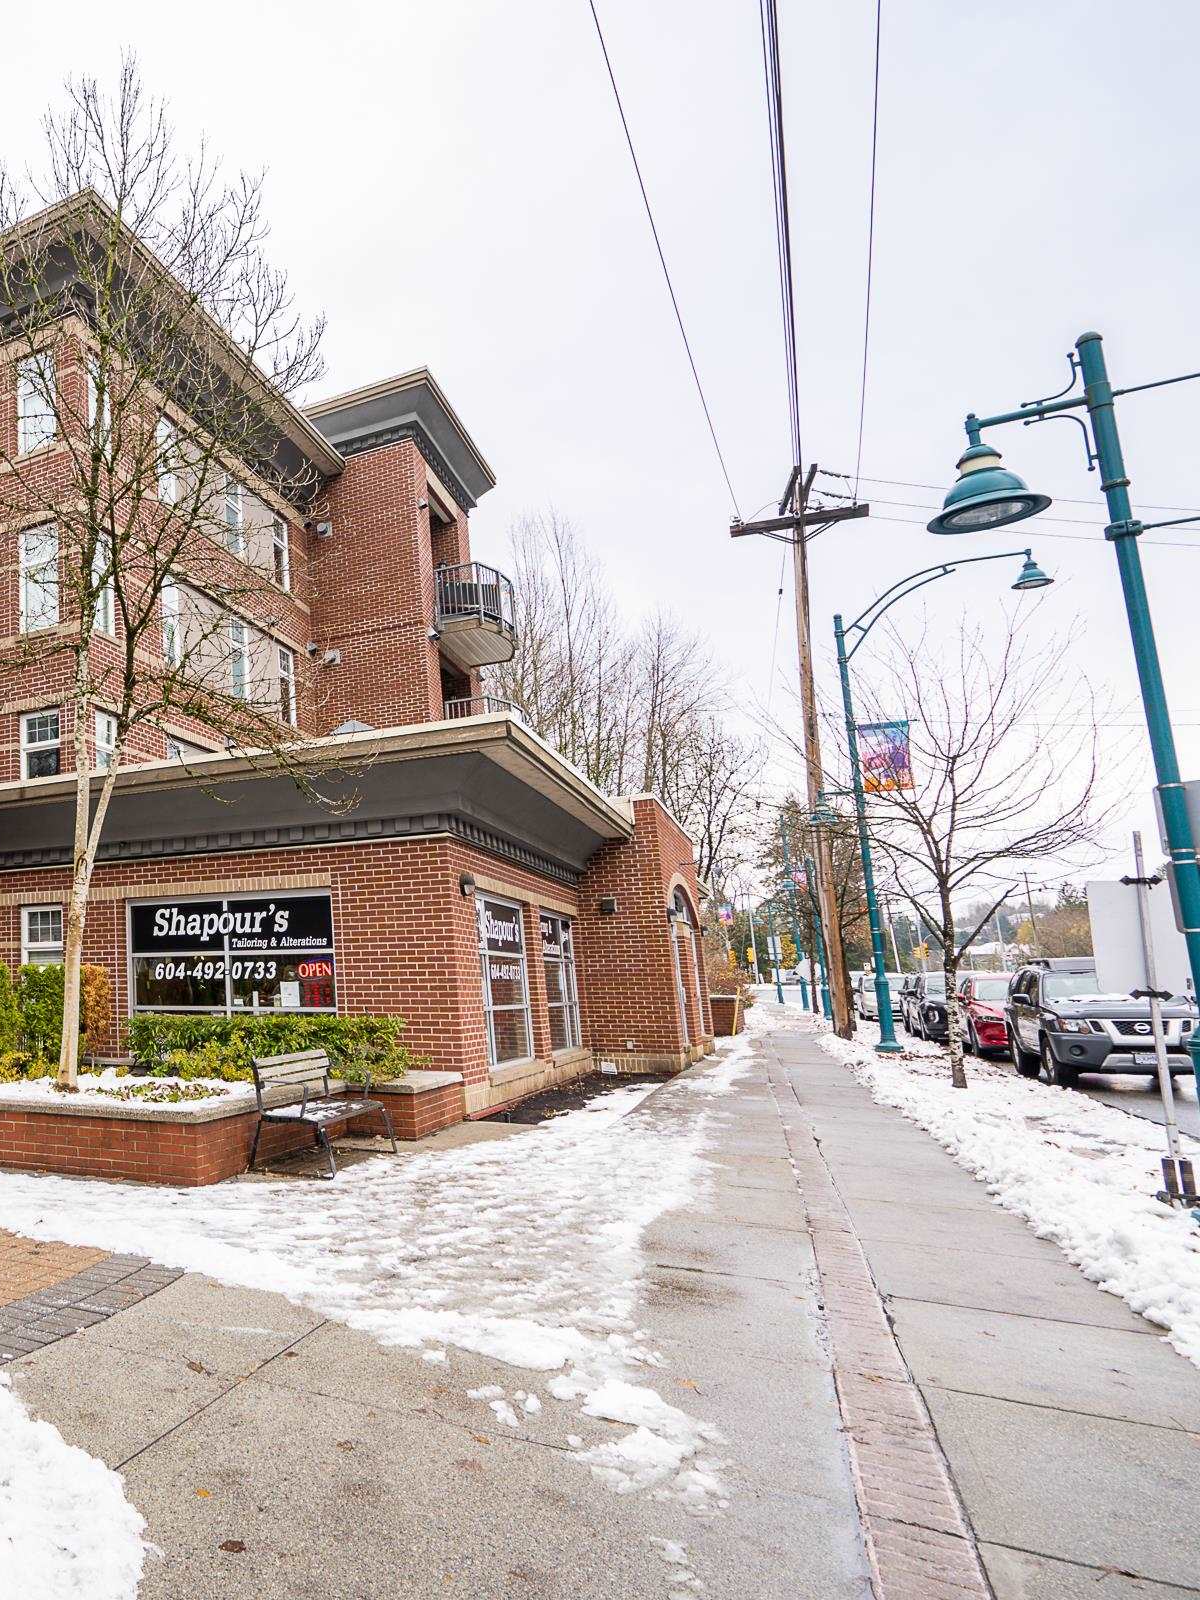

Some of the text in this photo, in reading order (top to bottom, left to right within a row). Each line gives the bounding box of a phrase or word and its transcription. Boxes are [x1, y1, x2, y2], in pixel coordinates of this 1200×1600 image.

[153, 903, 289, 941] Shapour's
[485, 910, 520, 946] Shapour's
[232, 936, 327, 949] Tailoring & Alterations
[155, 961, 277, 980] 604-492-0733
[298, 962, 332, 978] OPEN
